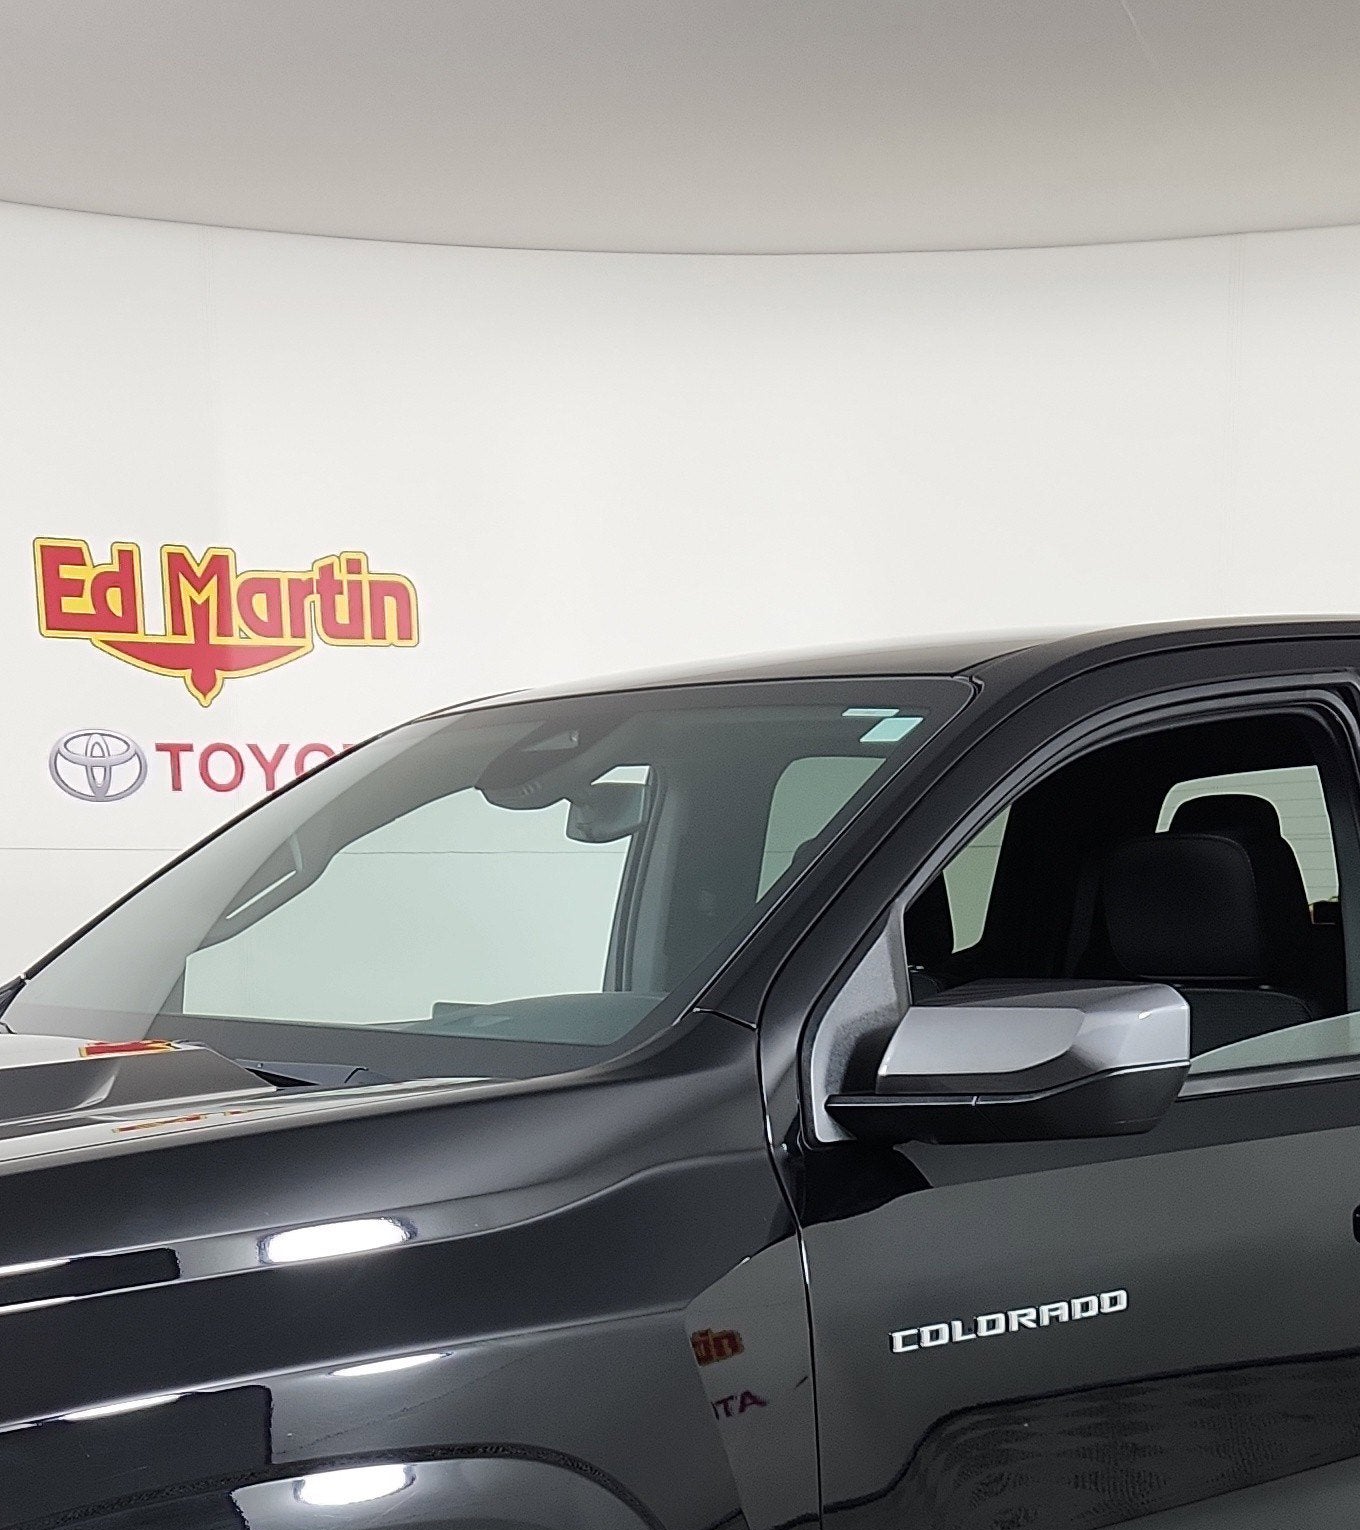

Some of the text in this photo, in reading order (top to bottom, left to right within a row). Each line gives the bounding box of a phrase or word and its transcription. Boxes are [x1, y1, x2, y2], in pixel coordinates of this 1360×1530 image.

[37, 542, 415, 645] Ed Martin
[155, 742, 353, 793] TOYO
[891, 1289, 1128, 1354] COLORADO
